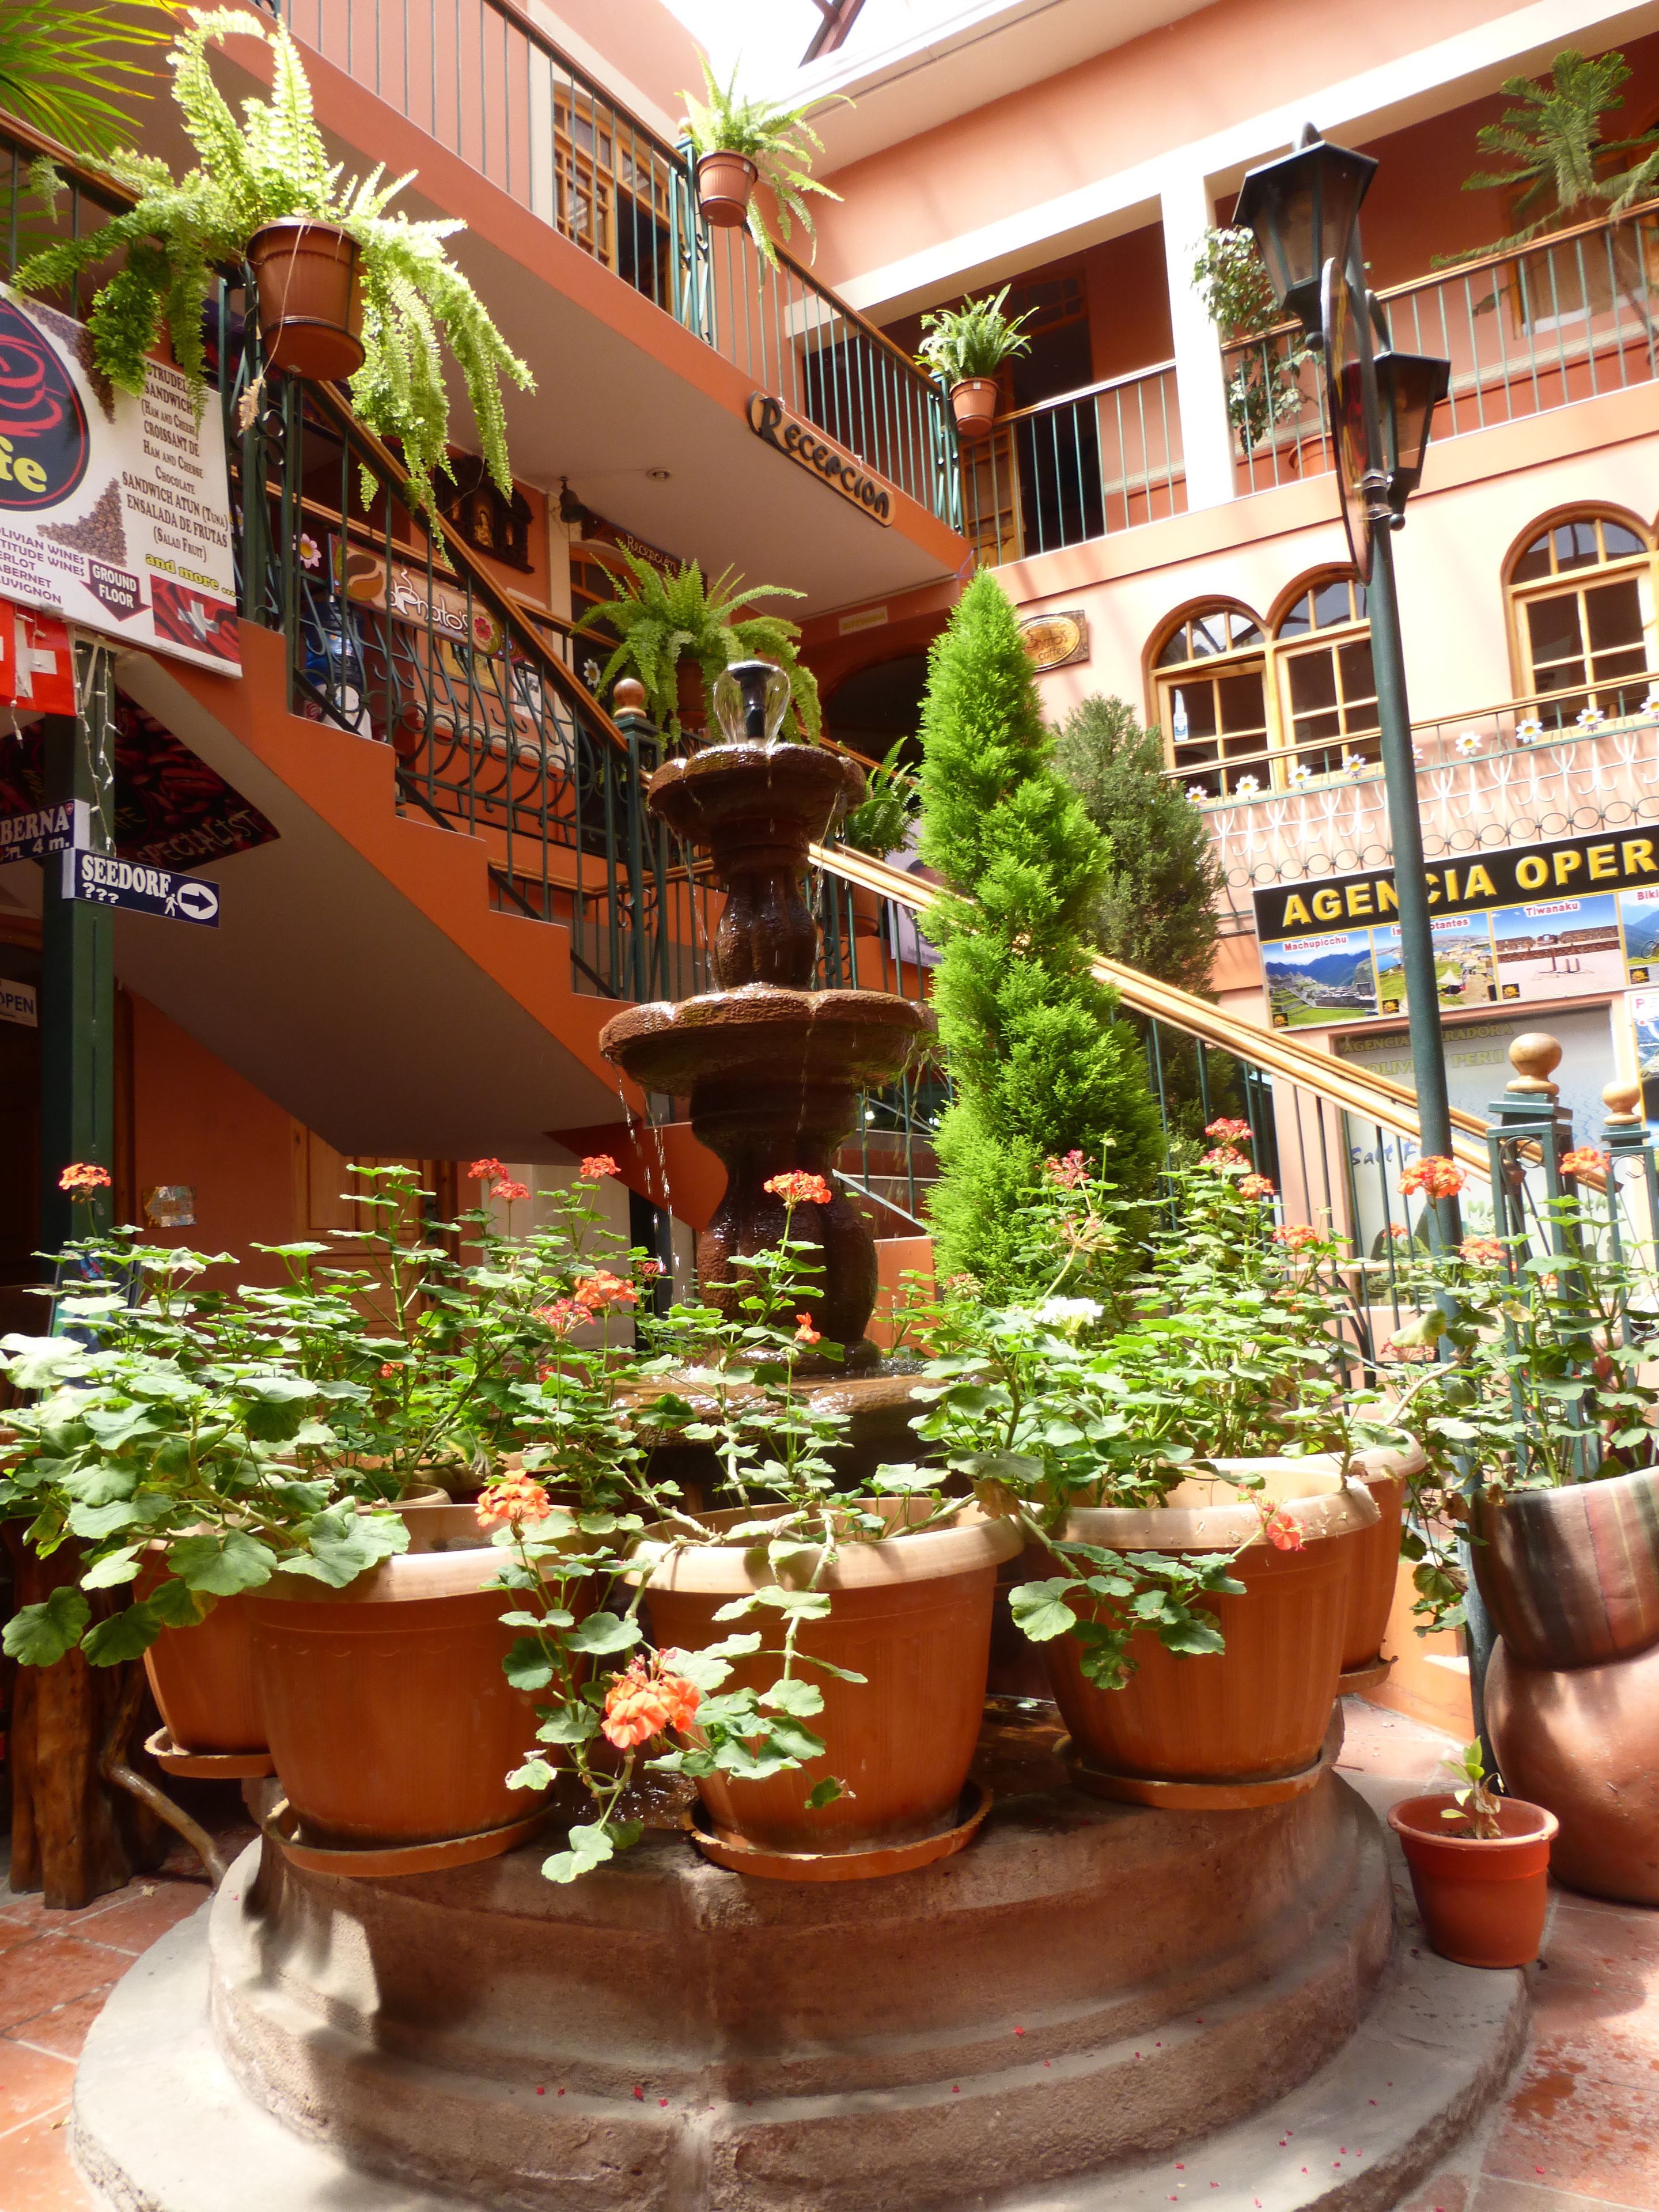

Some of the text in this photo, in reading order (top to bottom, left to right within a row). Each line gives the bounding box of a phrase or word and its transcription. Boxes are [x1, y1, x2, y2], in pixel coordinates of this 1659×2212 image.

[145, 382, 193, 415] SANDWICH
[145, 421, 199, 457] CROISSANT DE
[122, 471, 173, 505] SANDWICH
[176, 495, 200, 516] ATUN
[127, 494, 227, 547] ENSALADA DE FRUTAS
[0, 527, 85, 565] LIVIAN WINES
[0, 539, 85, 577] TITUDE WINES
[92, 565, 137, 592] GROUND
[146, 554, 176, 574] and
[179, 567, 219, 590] more
[0, 576, 62, 604] UVIGNON
[99, 584, 134, 608] FLOOR
[0, 805, 70, 845] BERNA
[32, 838, 44, 854] 4
[81, 854, 172, 898] SEEDORF
[1515, 839, 1659, 891] OPER
[1430, 919, 1468, 930] otantes
[1526, 902, 1578, 916] Tiwanaku
[1284, 935, 1347, 952] Machupicchu
[1343, 1023, 1514, 1054] AGENCIA RADORA
[1359, 1059, 1414, 1076] OLIV
[1452, 1049, 1505, 1069] PERU
